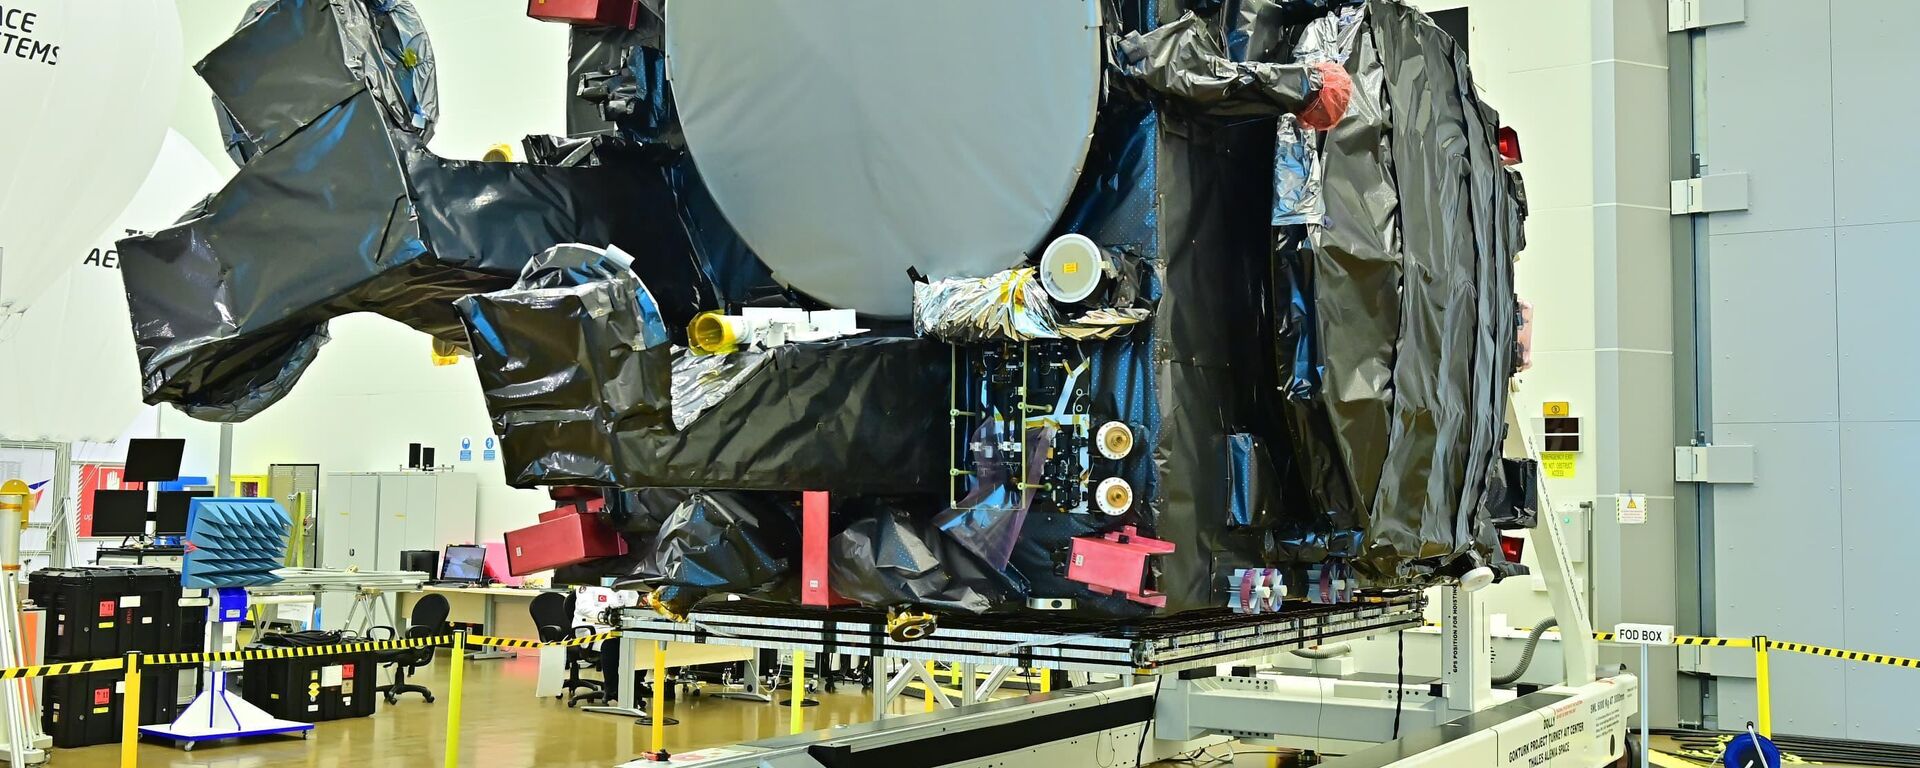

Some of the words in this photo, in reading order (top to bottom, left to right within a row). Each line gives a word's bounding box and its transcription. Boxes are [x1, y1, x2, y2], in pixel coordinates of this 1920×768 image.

[1619, 629, 1639, 640] FOD
[1642, 630, 1662, 641] BOX
[1543, 717, 1555, 730] DOLLY
[1508, 743, 1529, 763] GOKTURK
[1530, 735, 1548, 752] PROJECT
[1548, 728, 1564, 744] TURKEY
[1570, 722, 1584, 736] CENTER
[1528, 752, 1544, 768] THALES
[1544, 746, 1558, 761] ALENIA
[1558, 741, 1570, 756] SPACE
